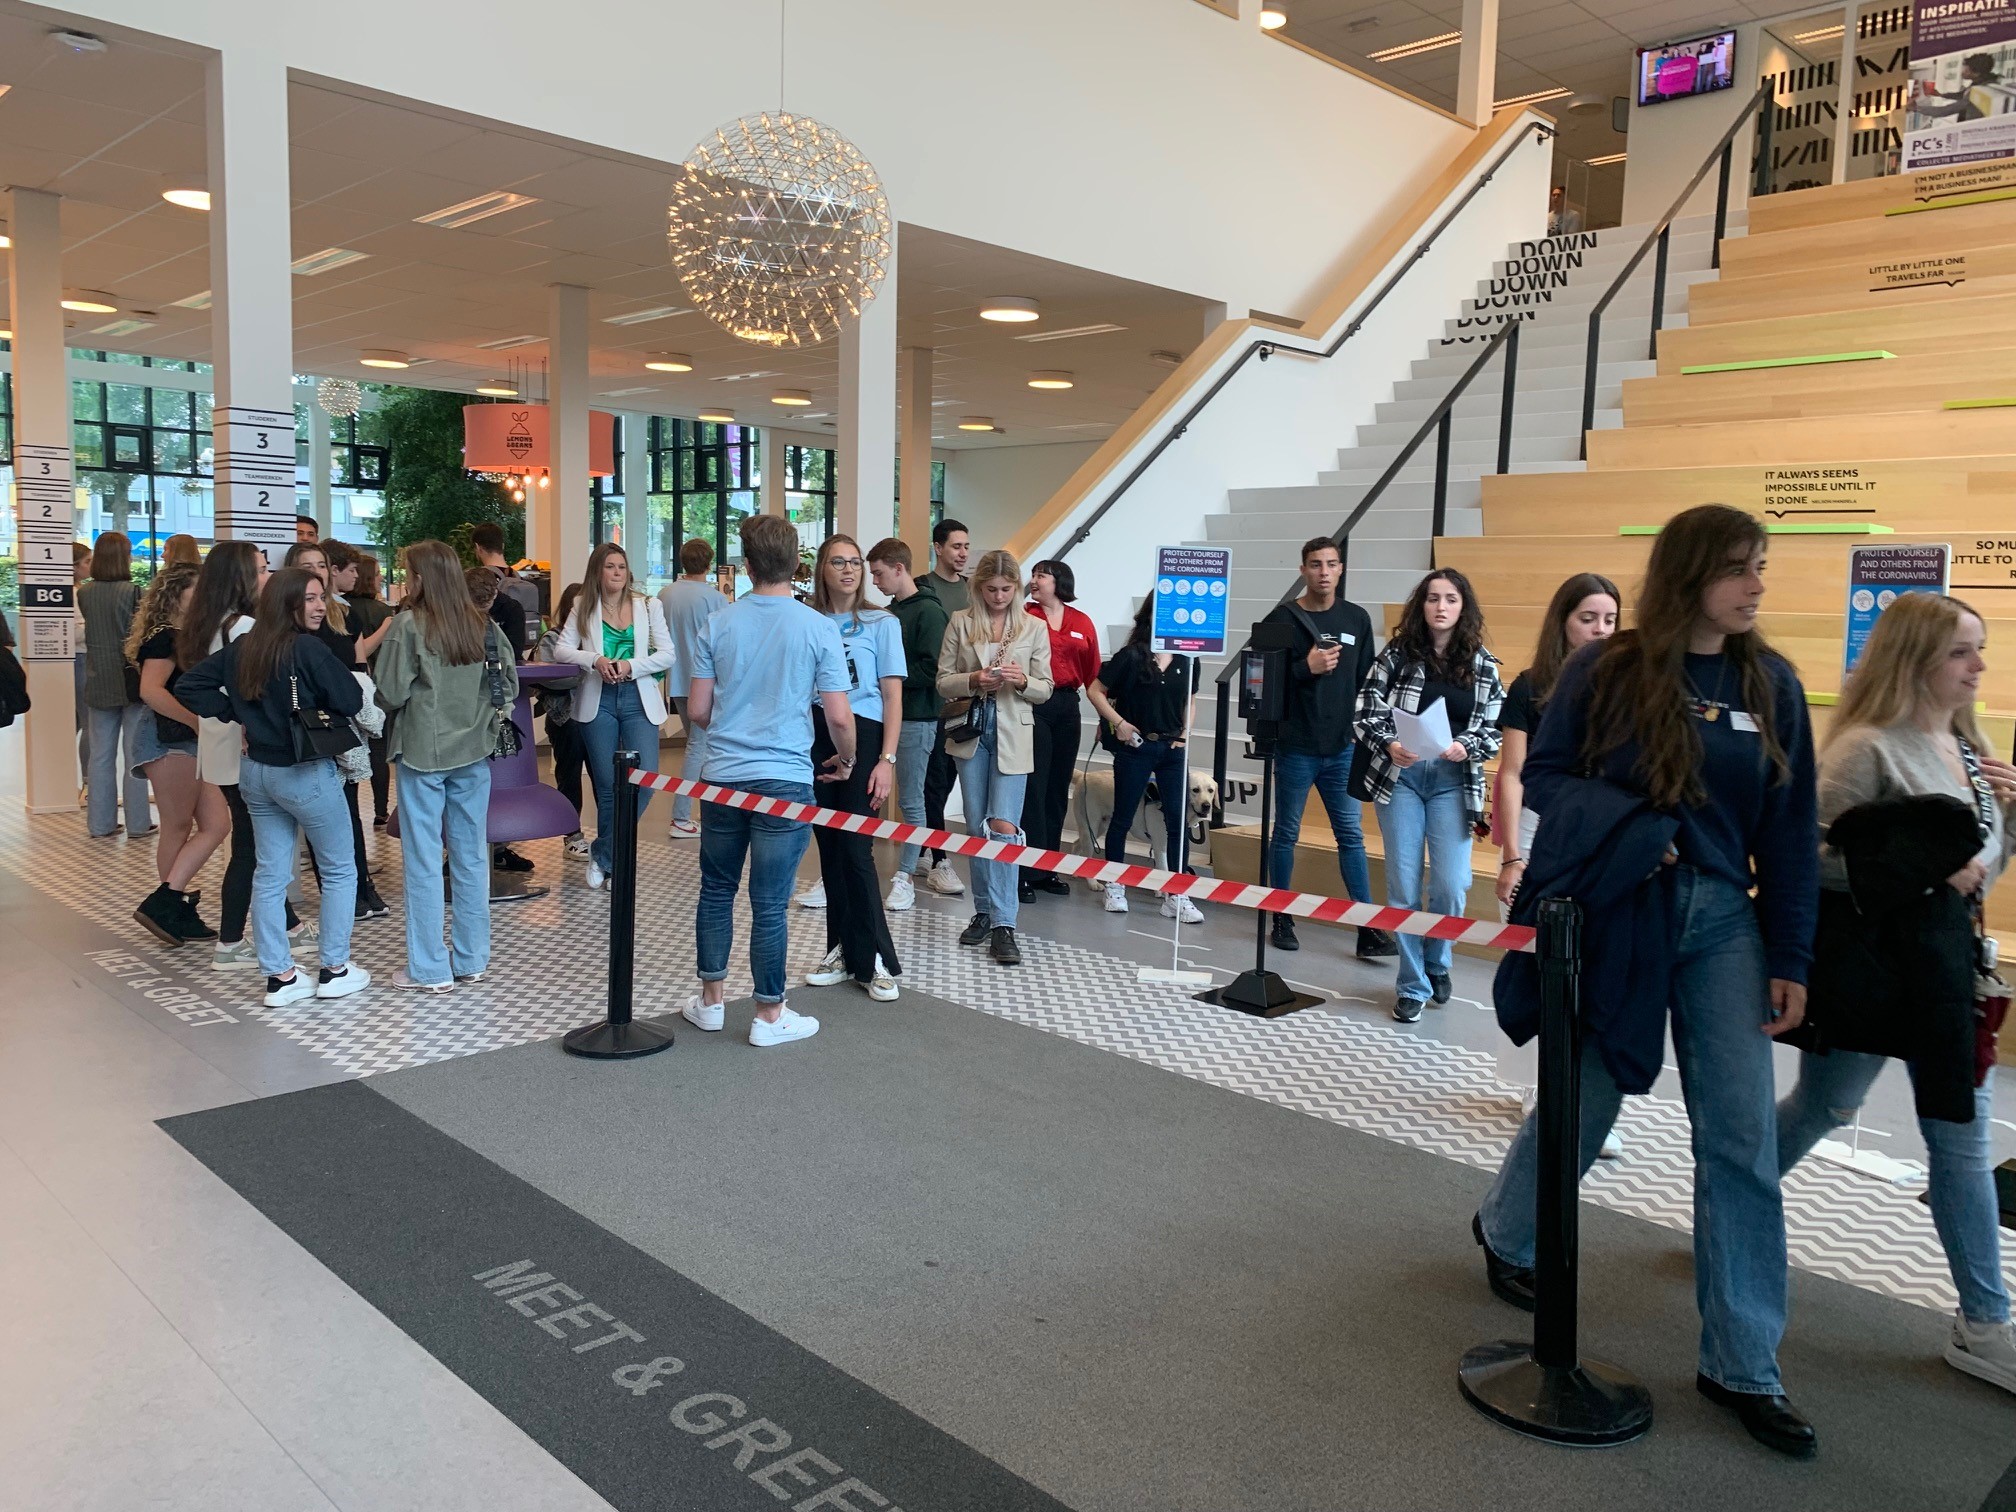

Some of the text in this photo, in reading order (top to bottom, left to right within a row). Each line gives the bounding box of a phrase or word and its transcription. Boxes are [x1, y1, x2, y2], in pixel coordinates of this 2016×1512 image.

[1921, 0, 2009, 19] INSPIRATIE
[1928, 173, 1946, 181] NOT
[1936, 178, 1977, 189] BUSINESS
[1521, 232, 1598, 258] DOWN
[1505, 251, 1583, 277] DOWN
[1869, 256, 1966, 274] LITTLE BY LITTLE ONE
[1886, 272, 1926, 282] TRAVELS
[1927, 269, 1944, 278] FAR
[1490, 270, 1568, 295] DOWN
[256, 432, 268, 449] 3
[40, 462, 51, 475] 3
[1777, 470, 1820, 479] ALWAYS
[1822, 469, 1859, 478] SEEMS
[1765, 482, 1877, 492] IMPOSSIBLE UNTIL IT
[257, 491, 270, 507] 2
[1776, 496, 1808, 505] DONE
[42, 505, 52, 517] 2
[1976, 540, 1995, 550] SO
[44, 548, 53, 560] 1
[1163, 549, 1225, 558] PROTECT YOURSELF
[1898, 549, 1939, 557] YOURSELF
[1860, 560, 1938, 569] AND OTHERS FROM
[1993, 555, 2013, 564] TO
[1177, 566, 1223, 574] CORONAVIRUS
[1861, 571, 1938, 580] THE CORONAVIRUS
[36, 589, 63, 602] BG
[83, 948, 162, 978] MEET
[127, 977, 173, 989] &
[143, 986, 240, 1027] GREET
[472, 1258, 647, 1354] MEET
[611, 1356, 685, 1396] &
[669, 1392, 902, 1512] GREE
